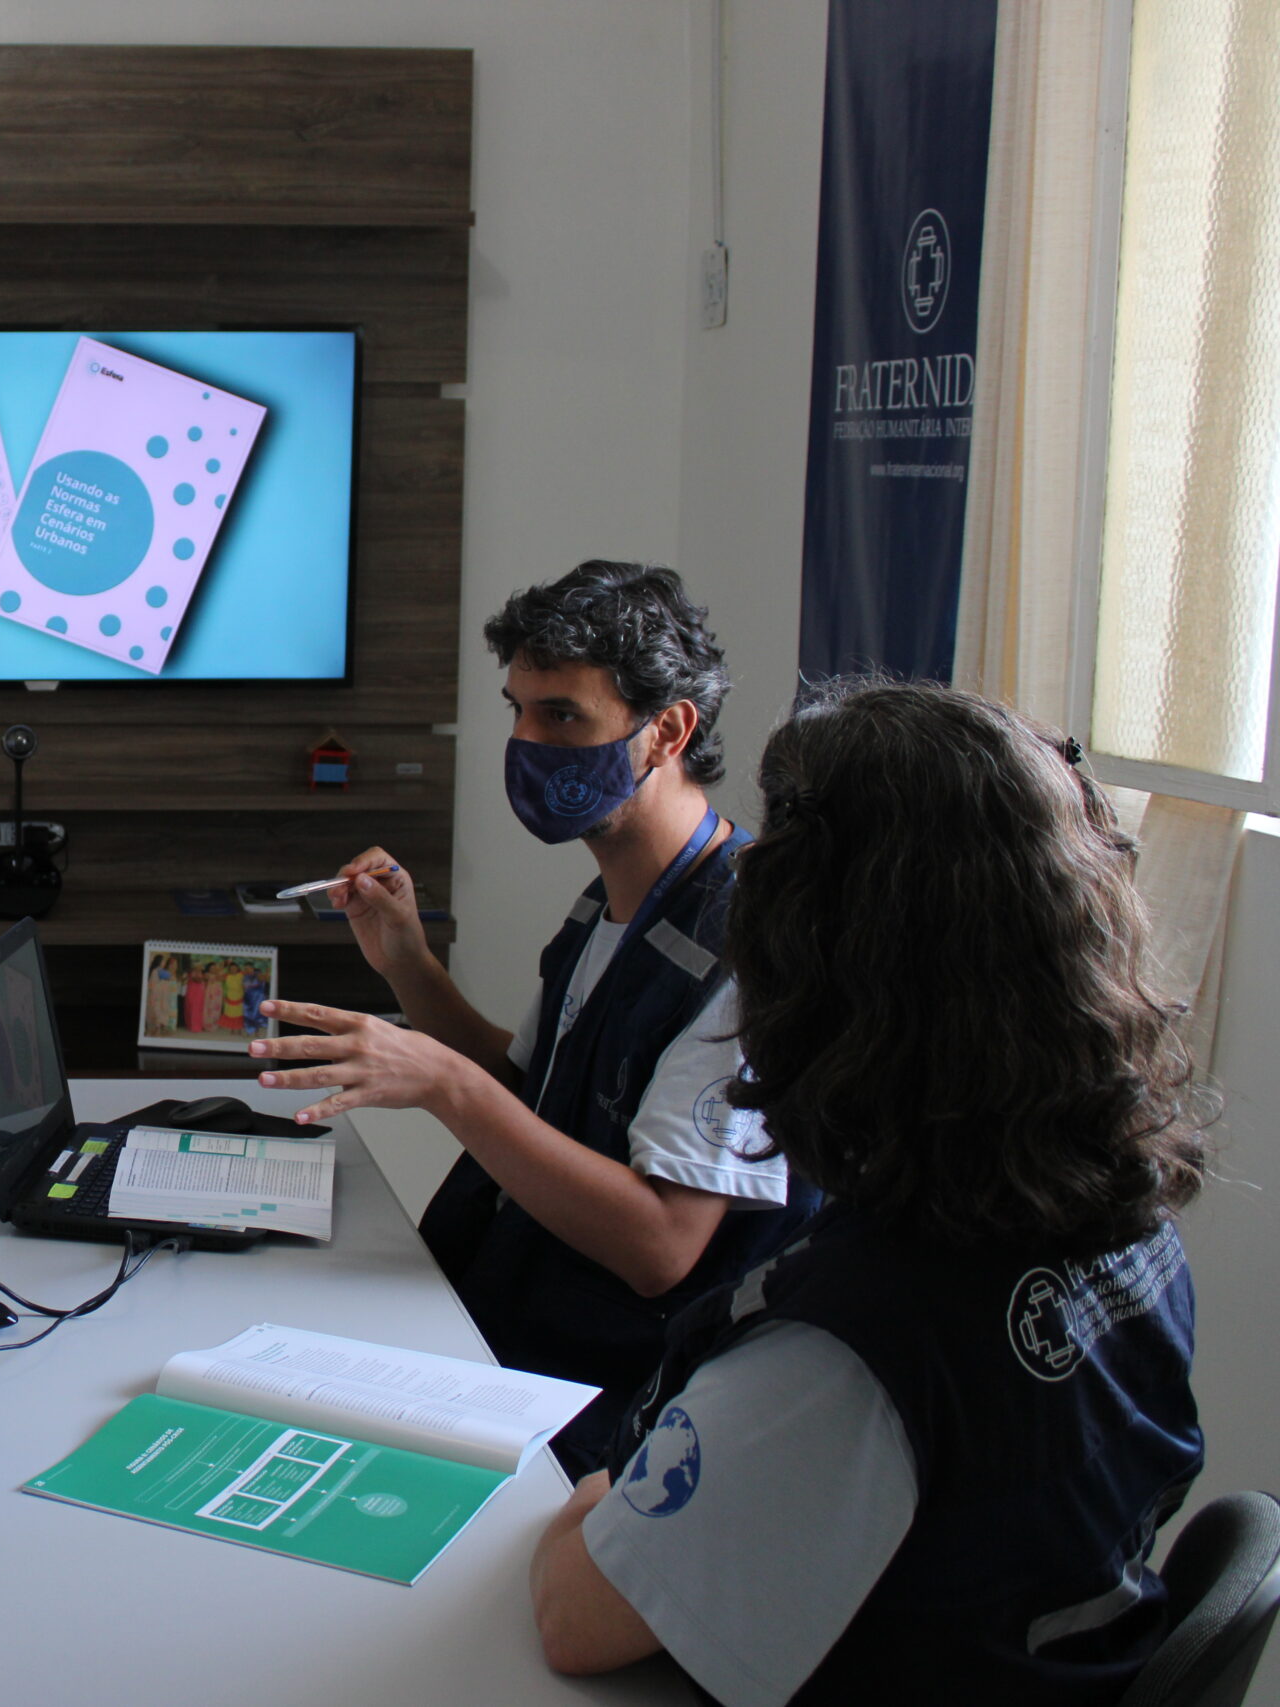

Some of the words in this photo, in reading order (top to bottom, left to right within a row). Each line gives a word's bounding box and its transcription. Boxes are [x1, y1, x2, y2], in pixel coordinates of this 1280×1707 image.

[835, 353, 974, 412] FRATERNID
[51, 485, 101, 513] Normas
[56, 471, 104, 499] Usando
[104, 493, 120, 505] as
[40, 512, 95, 543] Cenários
[45, 499, 84, 521] Esfera
[85, 517, 107, 531] em
[34, 526, 88, 555] Urbanos
